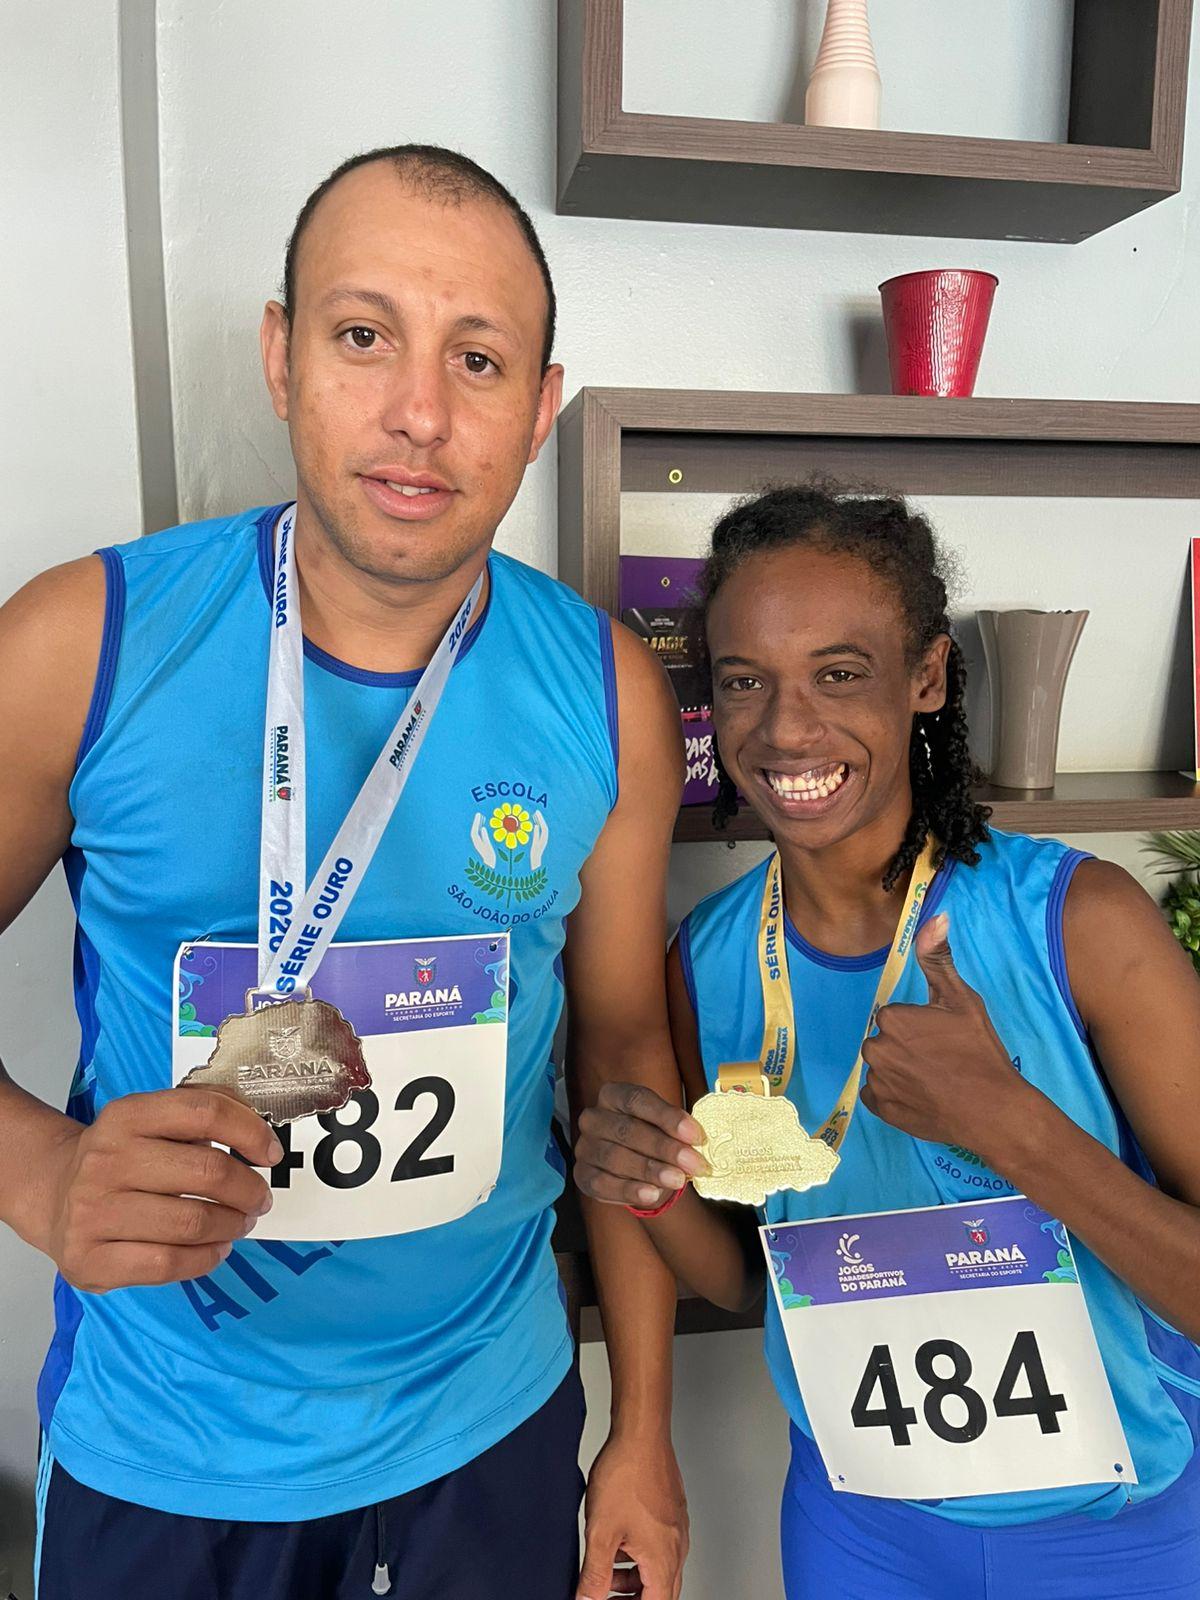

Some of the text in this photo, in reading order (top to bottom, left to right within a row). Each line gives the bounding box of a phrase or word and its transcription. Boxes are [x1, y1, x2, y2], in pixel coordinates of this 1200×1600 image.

[276, 572, 287, 629] OURO
[276, 725, 291, 785] PARANÁ
[389, 714, 417, 767] PARANÁ
[471, 781, 548, 808] ESCOLA
[447, 884, 474, 909] SÃO
[473, 906, 510, 925] JOÃO
[511, 913, 530, 925] DO
[276, 857, 353, 993] SÉRIE OURO
[765, 923, 781, 980] SÉRIE
[385, 985, 462, 1008] PARANÁ
[735, 1146, 773, 1157] JOGOS
[934, 1156, 961, 1179] SÃO
[963, 1174, 1003, 1191] JOÃO
[838, 1263, 875, 1276] JOGOS
[945, 1244, 1026, 1267] PARANÁ
[838, 1270, 904, 1282] PARADESPORTIVOS
[840, 1275, 907, 1292] DO PARANÁ
[850, 1330, 1068, 1447] 484
